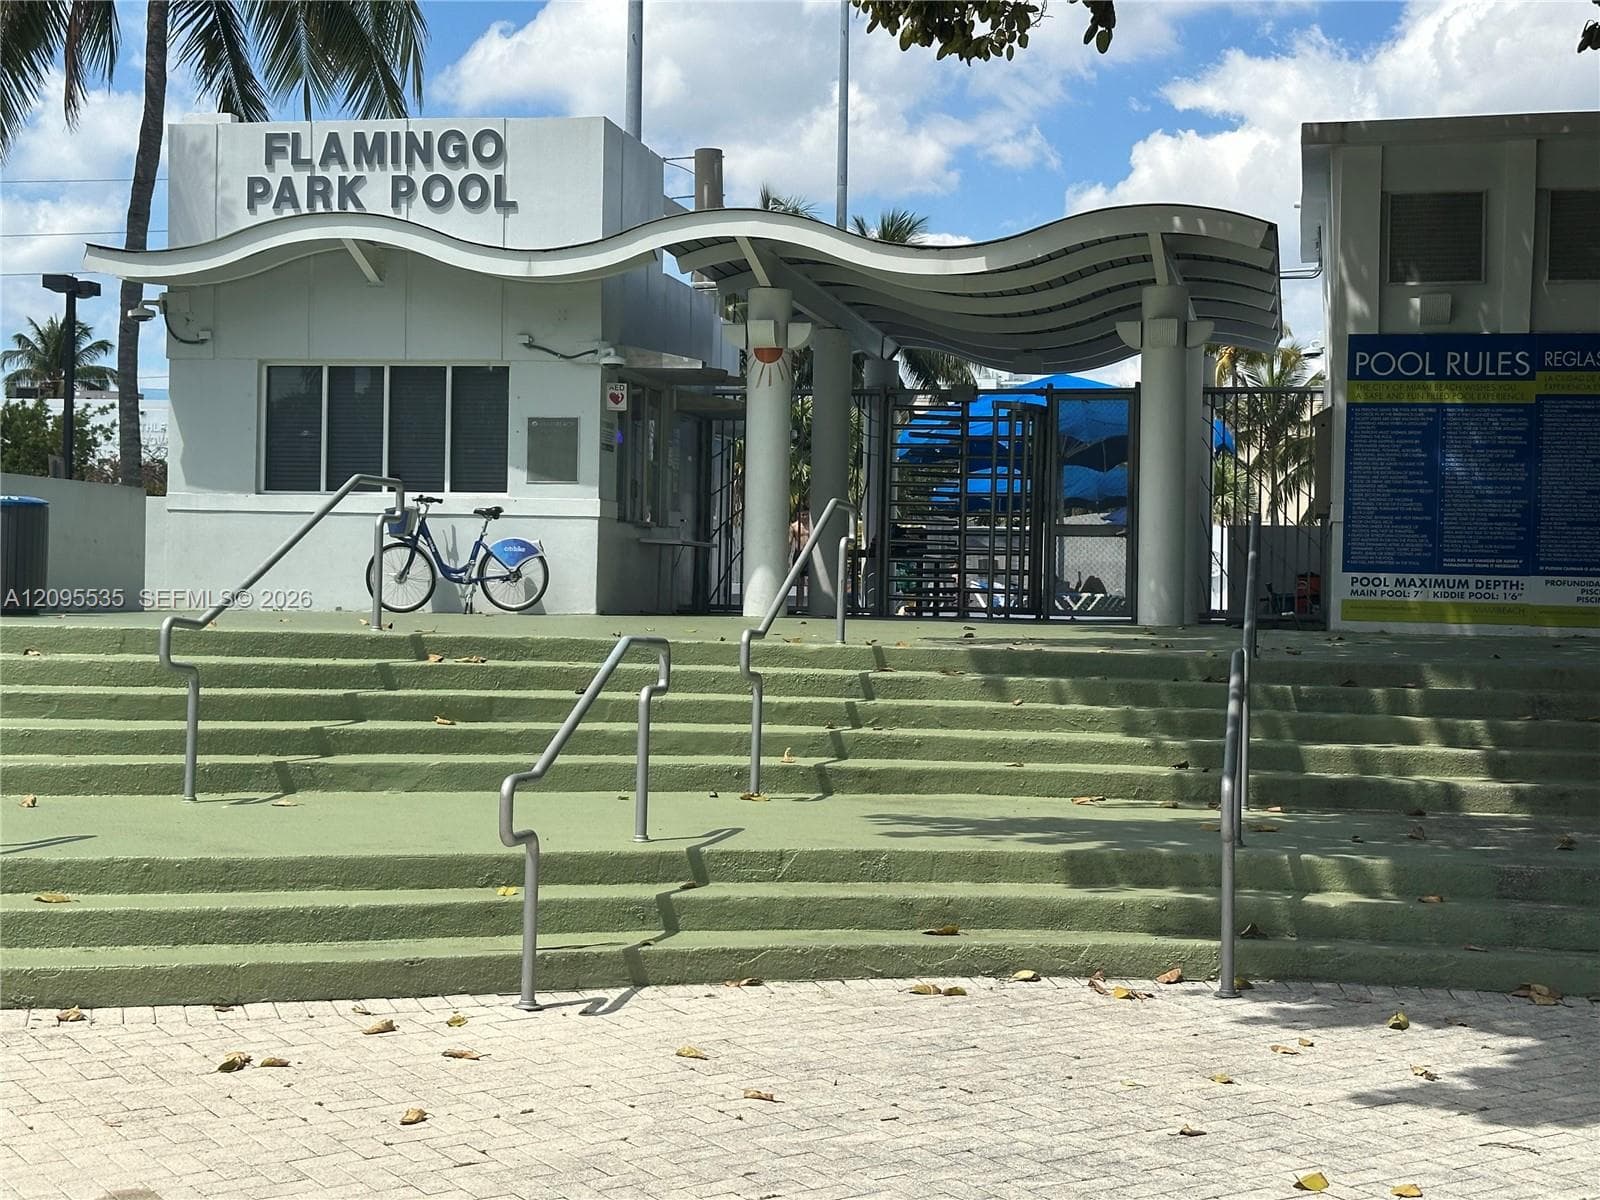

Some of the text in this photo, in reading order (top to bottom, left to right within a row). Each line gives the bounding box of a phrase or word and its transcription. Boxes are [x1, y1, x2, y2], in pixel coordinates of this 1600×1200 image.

[264, 128, 505, 169] FLAMINGO
[247, 173, 518, 212] PARK POOL
[1355, 351, 1531, 376] POOL RULES
[1373, 383, 1391, 392] CITY
[1393, 383, 1404, 392] OF
[1407, 383, 1432, 392] MIAMI
[1435, 383, 1462, 392] BEACH
[1464, 383, 1496, 393] WISHES
[1387, 392, 1405, 400] AND
[1408, 392, 1424, 400] FUN
[1426, 392, 1450, 400] FILLED
[1452, 392, 1474, 400] POOL
[1351, 576, 1525, 591] POOL MAXIMUM DEPTH:
[1350, 589, 1378, 598] MAIN
[1381, 589, 1410, 599] POOL:
[1433, 590, 1465, 600] KIDDIE
[1468, 591, 1499, 600] POOL:
